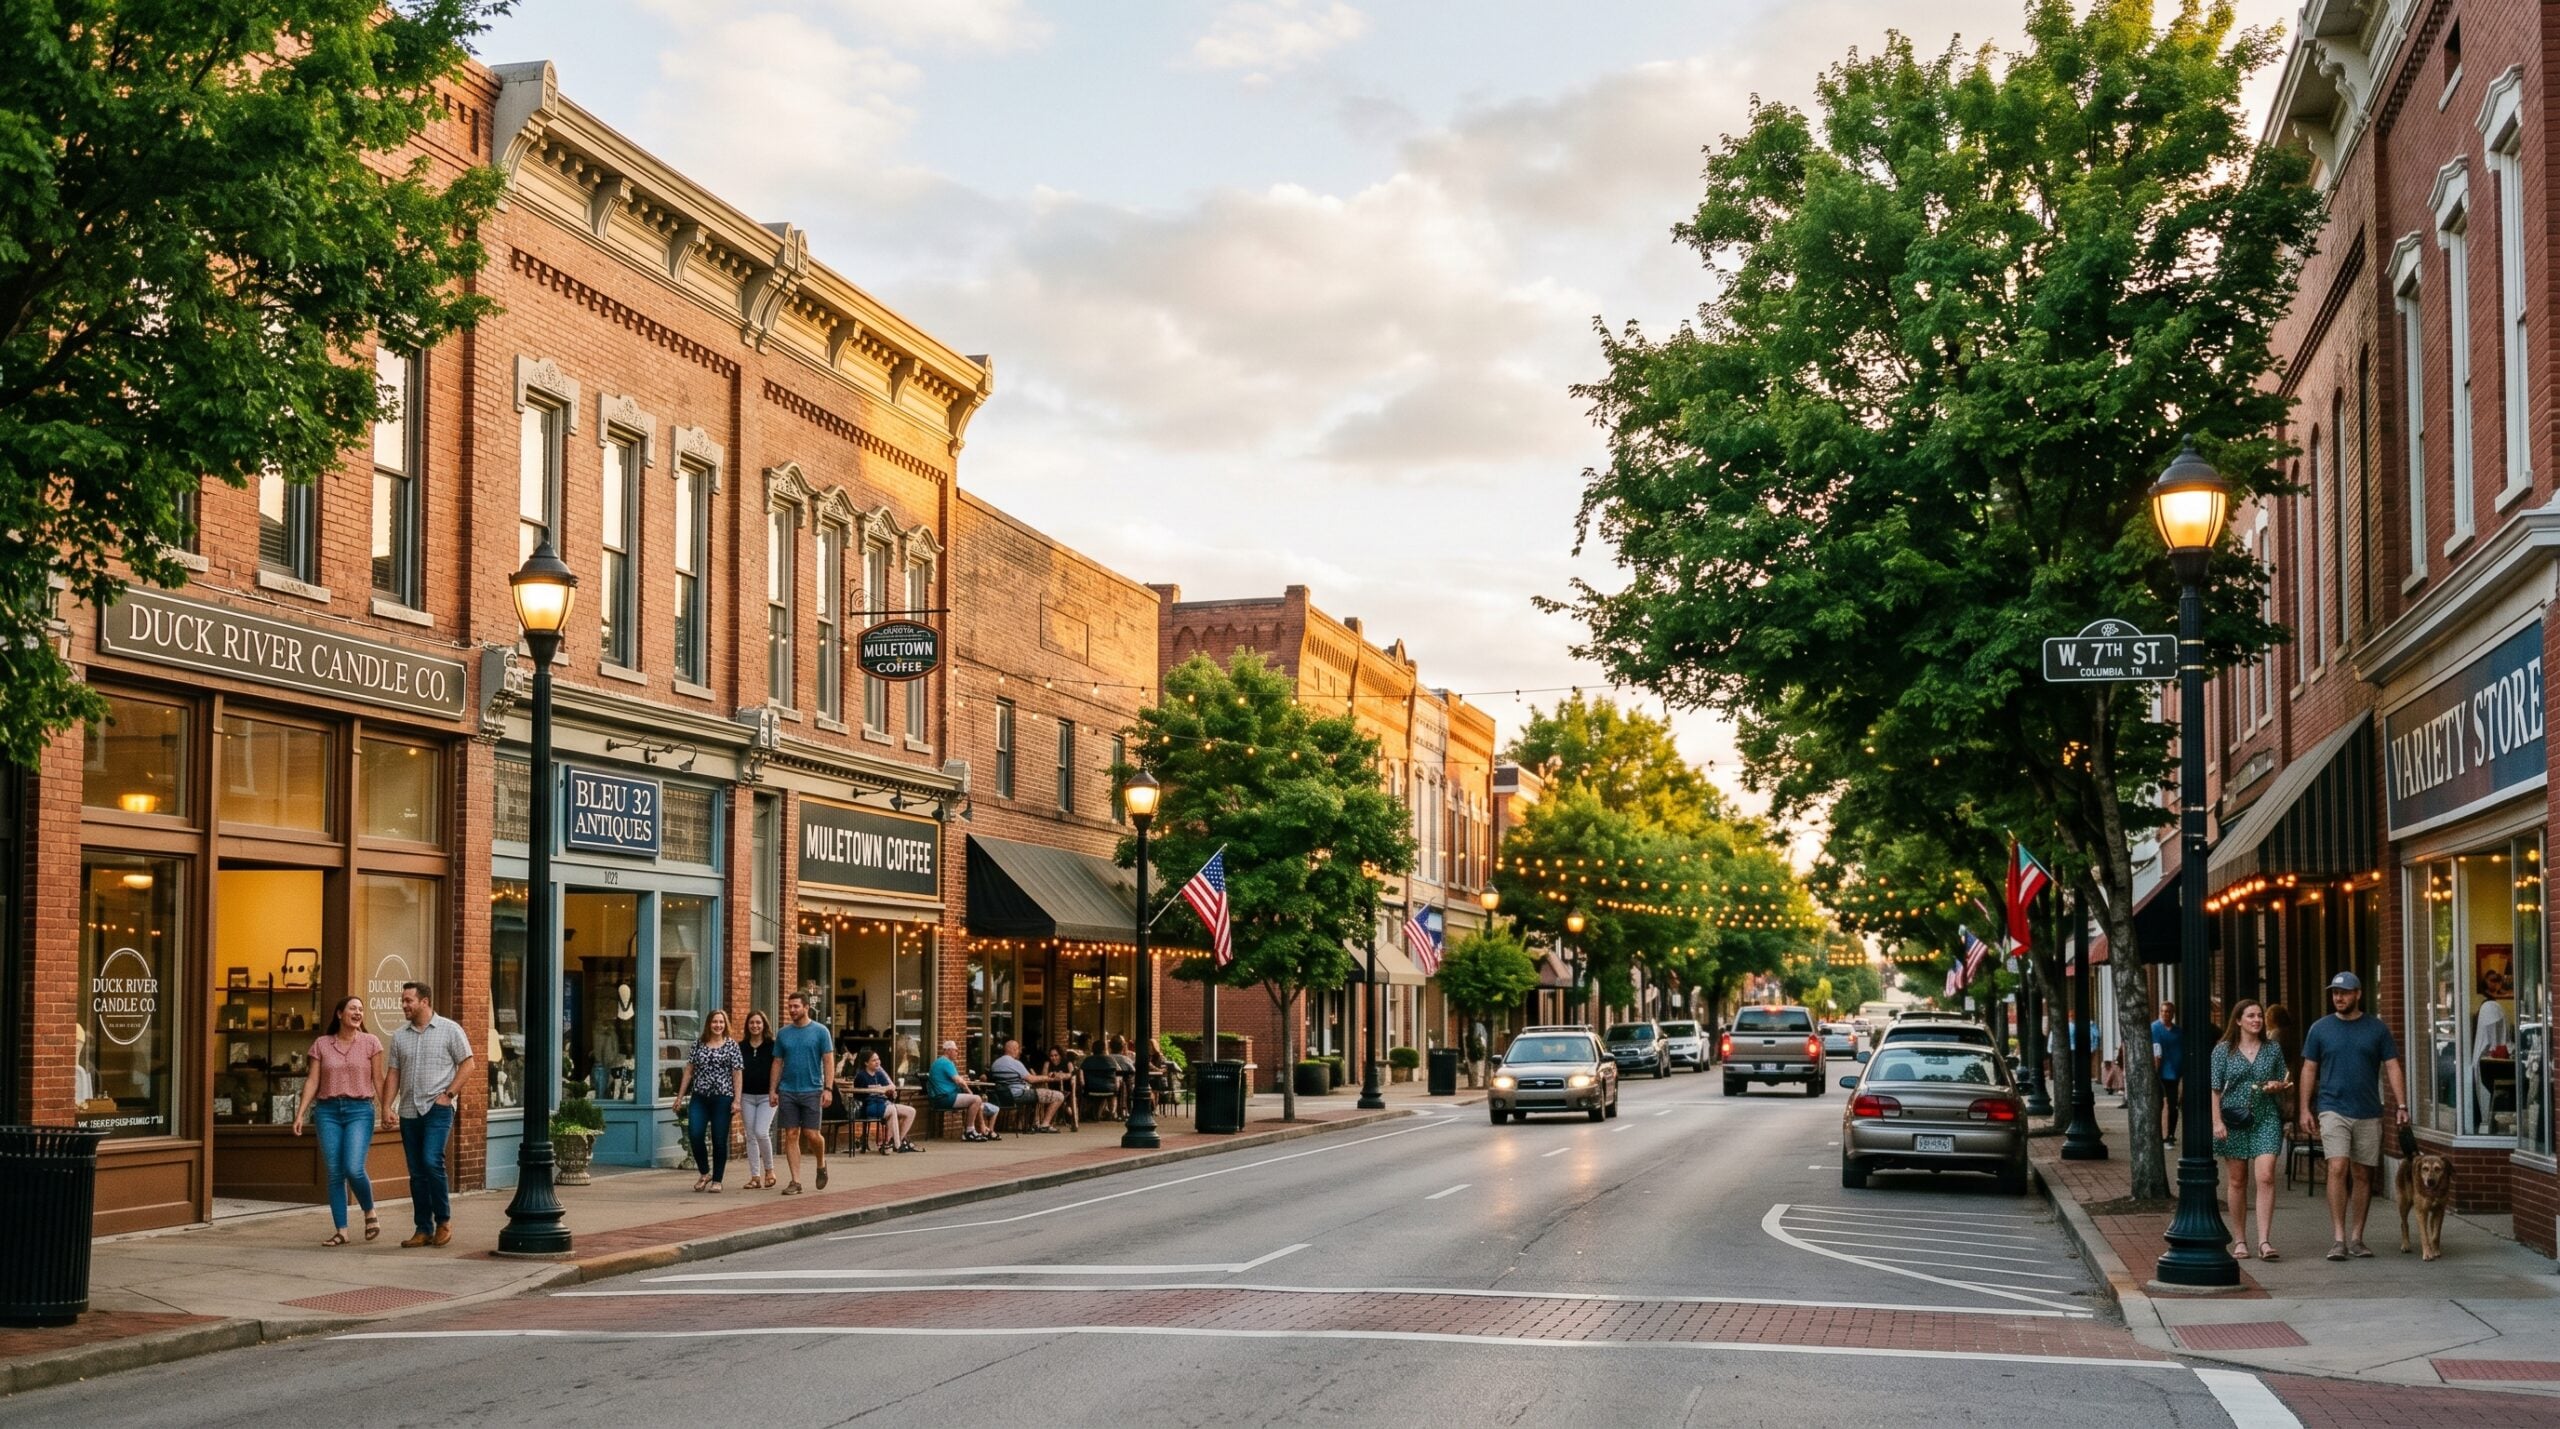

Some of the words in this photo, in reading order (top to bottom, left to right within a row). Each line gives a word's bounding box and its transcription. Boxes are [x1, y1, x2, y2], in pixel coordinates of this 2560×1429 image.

[130, 603, 216, 656] DUCK
[222, 623, 305, 674] RIVER
[311, 645, 409, 694] CANDLE
[415, 667, 450, 703] CO.
[864, 641, 933, 658] MULETOWN
[2058, 643, 2082, 667] W.
[2091, 642, 2123, 666] 7TH
[2132, 641, 2164, 665] ST.
[2130, 666, 2143, 676] TN
[2391, 701, 2467, 801] VARIETY
[2473, 656, 2543, 768] STORE
[575, 779, 628, 812] BLEU
[632, 788, 651, 816] 32
[574, 812, 652, 843] ANTIQUES
[806, 823, 882, 868] MULETOWN
[886, 836, 932, 874] COFFEE
[92, 978, 124, 993] DUCK
[126, 978, 158, 993] RIVER
[368, 980, 393, 993] DUCK
[93, 997, 138, 1012] CANDLE
[139, 997, 157, 1012] CO.
[370, 997, 403, 1010] CANDLE
